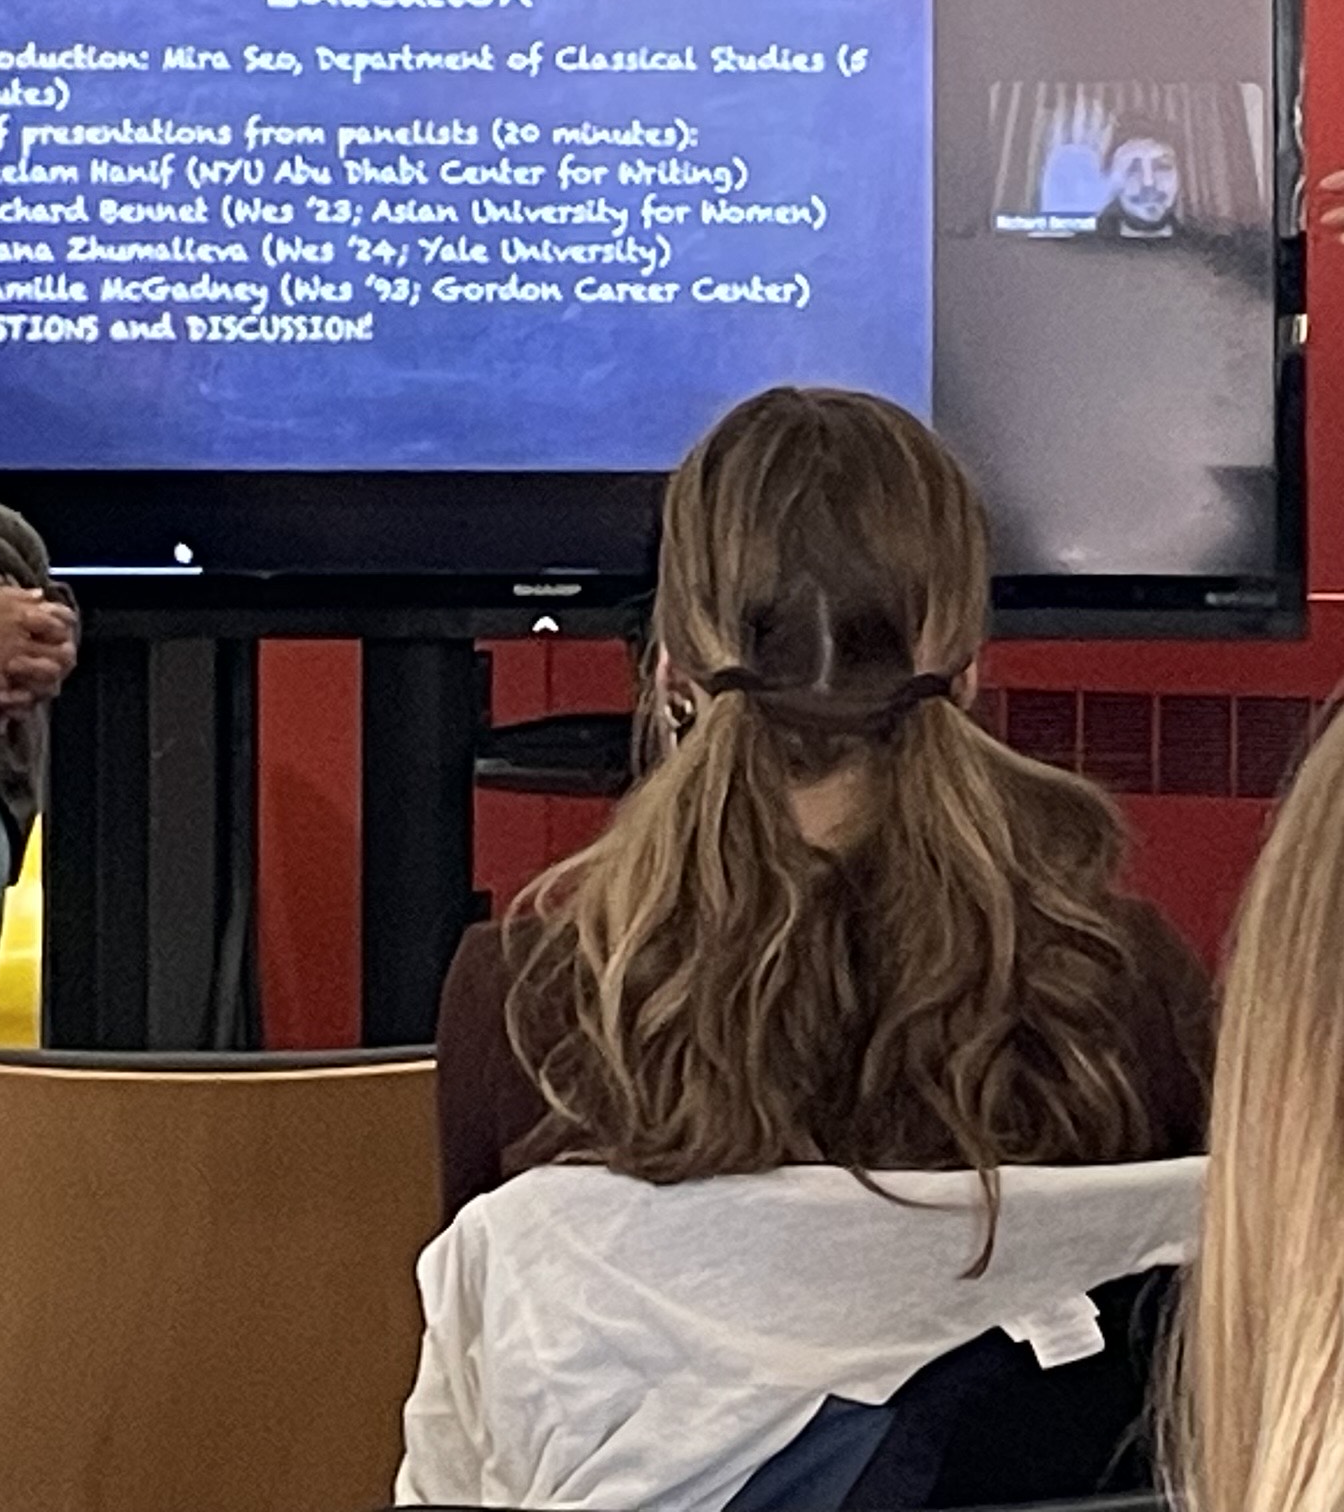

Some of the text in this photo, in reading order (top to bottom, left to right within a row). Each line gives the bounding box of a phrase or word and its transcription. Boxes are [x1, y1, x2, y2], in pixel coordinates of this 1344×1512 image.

[162, 45, 229, 71] Mira
[243, 44, 303, 76] Seo,
[315, 44, 494, 84] Department
[506, 43, 544, 78] of
[555, 44, 698, 72] Classical
[710, 44, 825, 73] Studies
[21, 117, 233, 160] presentations
[243, 113, 326, 152] from
[492, 117, 541, 151] (20
[552, 117, 698, 152] minutes):
[90, 155, 176, 190] Hanif
[185, 155, 265, 190] (NYU
[273, 155, 333, 185] Abu
[339, 155, 429, 185] Dhabi
[439, 157, 546, 186] Center
[557, 155, 605, 191] for
[618, 156, 748, 195] Writing)
[99, 195, 209, 225] Bennet
[221, 195, 294, 229] (Wes
[371, 198, 459, 224] Asian
[471, 197, 629, 231] University
[608, 195, 640, 230] for
[701, 195, 827, 231] Women)
[261, 235, 335, 269] (Wes
[417, 235, 490, 265] Yale
[500, 235, 671, 269] University)
[100, 273, 269, 311] McGadney
[280, 273, 353, 308] (Wes
[431, 273, 564, 303] Gordon
[573, 273, 681, 303] Career
[691, 273, 811, 309] Center)
[108, 313, 177, 342] and
